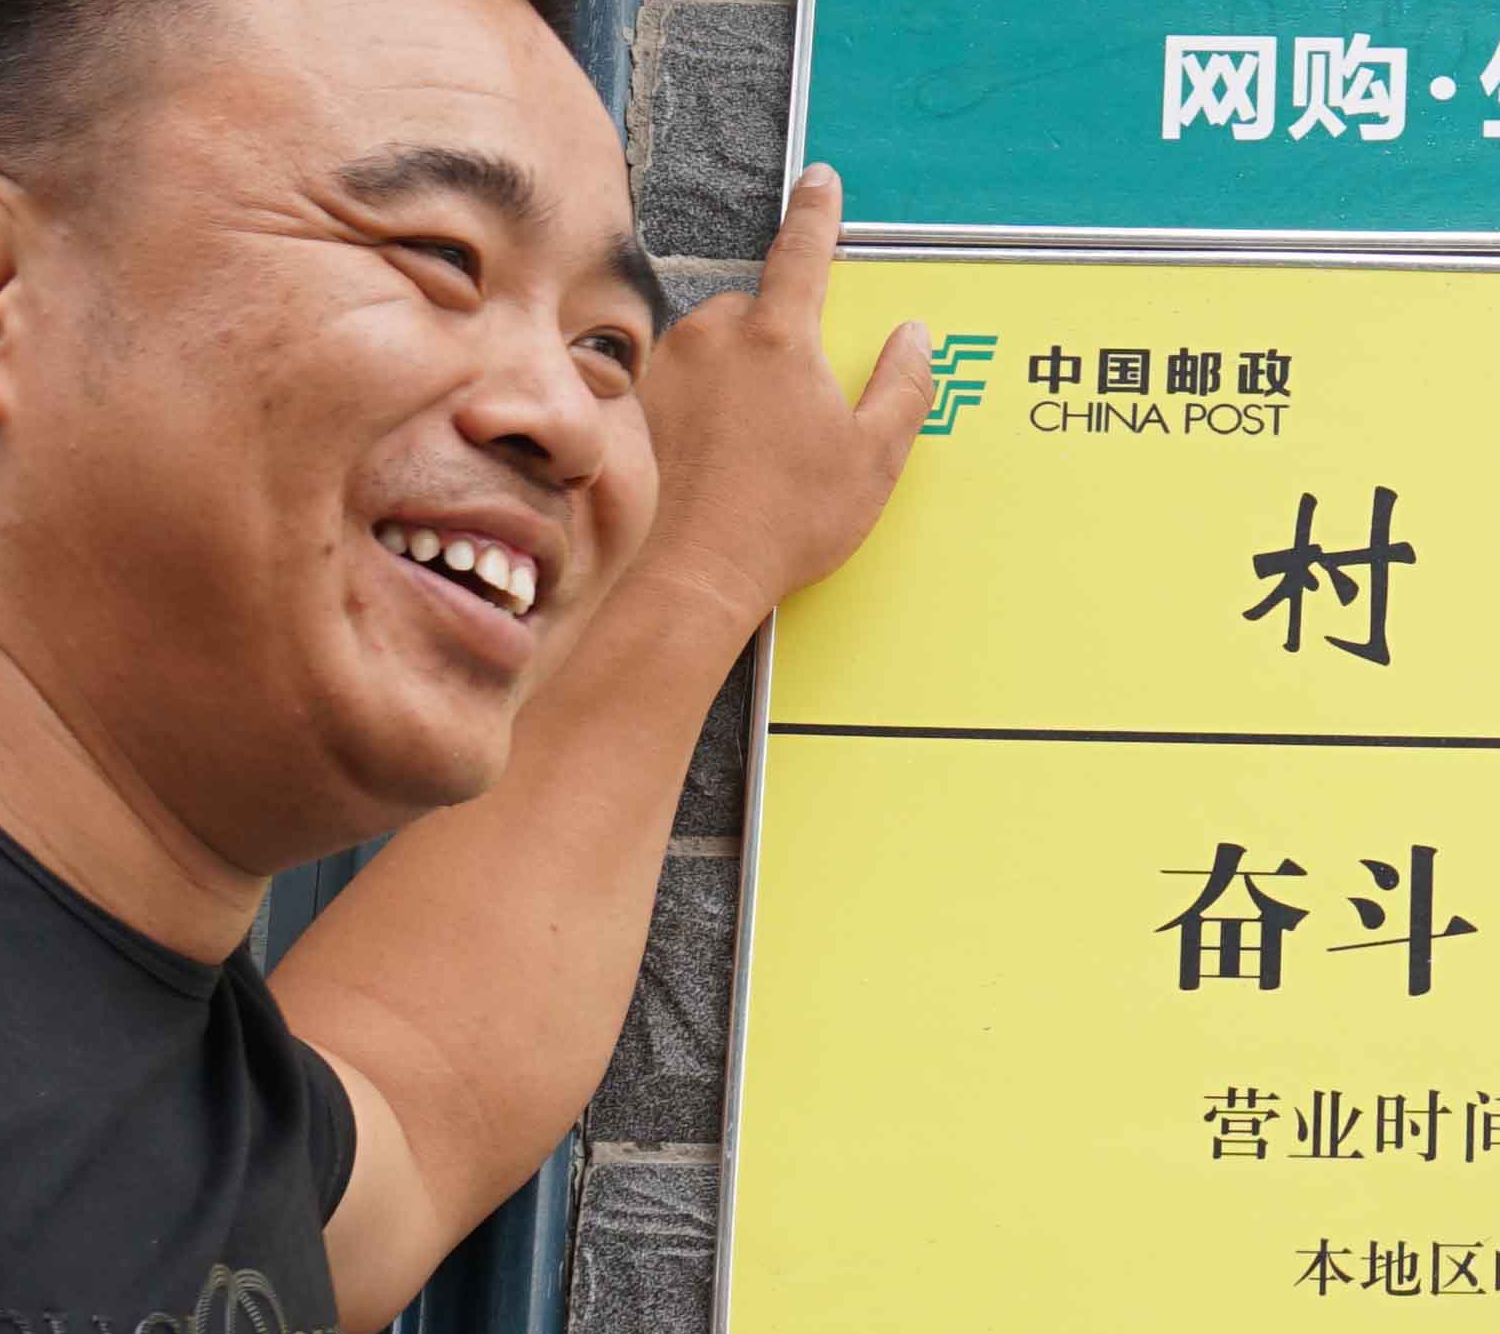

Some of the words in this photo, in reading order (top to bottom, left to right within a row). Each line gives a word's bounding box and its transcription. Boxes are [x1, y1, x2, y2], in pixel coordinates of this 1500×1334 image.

[1027, 344, 1293, 399] 中国邮政
[1028, 401, 1172, 435] CHINA
[1184, 402, 1291, 436] POST
